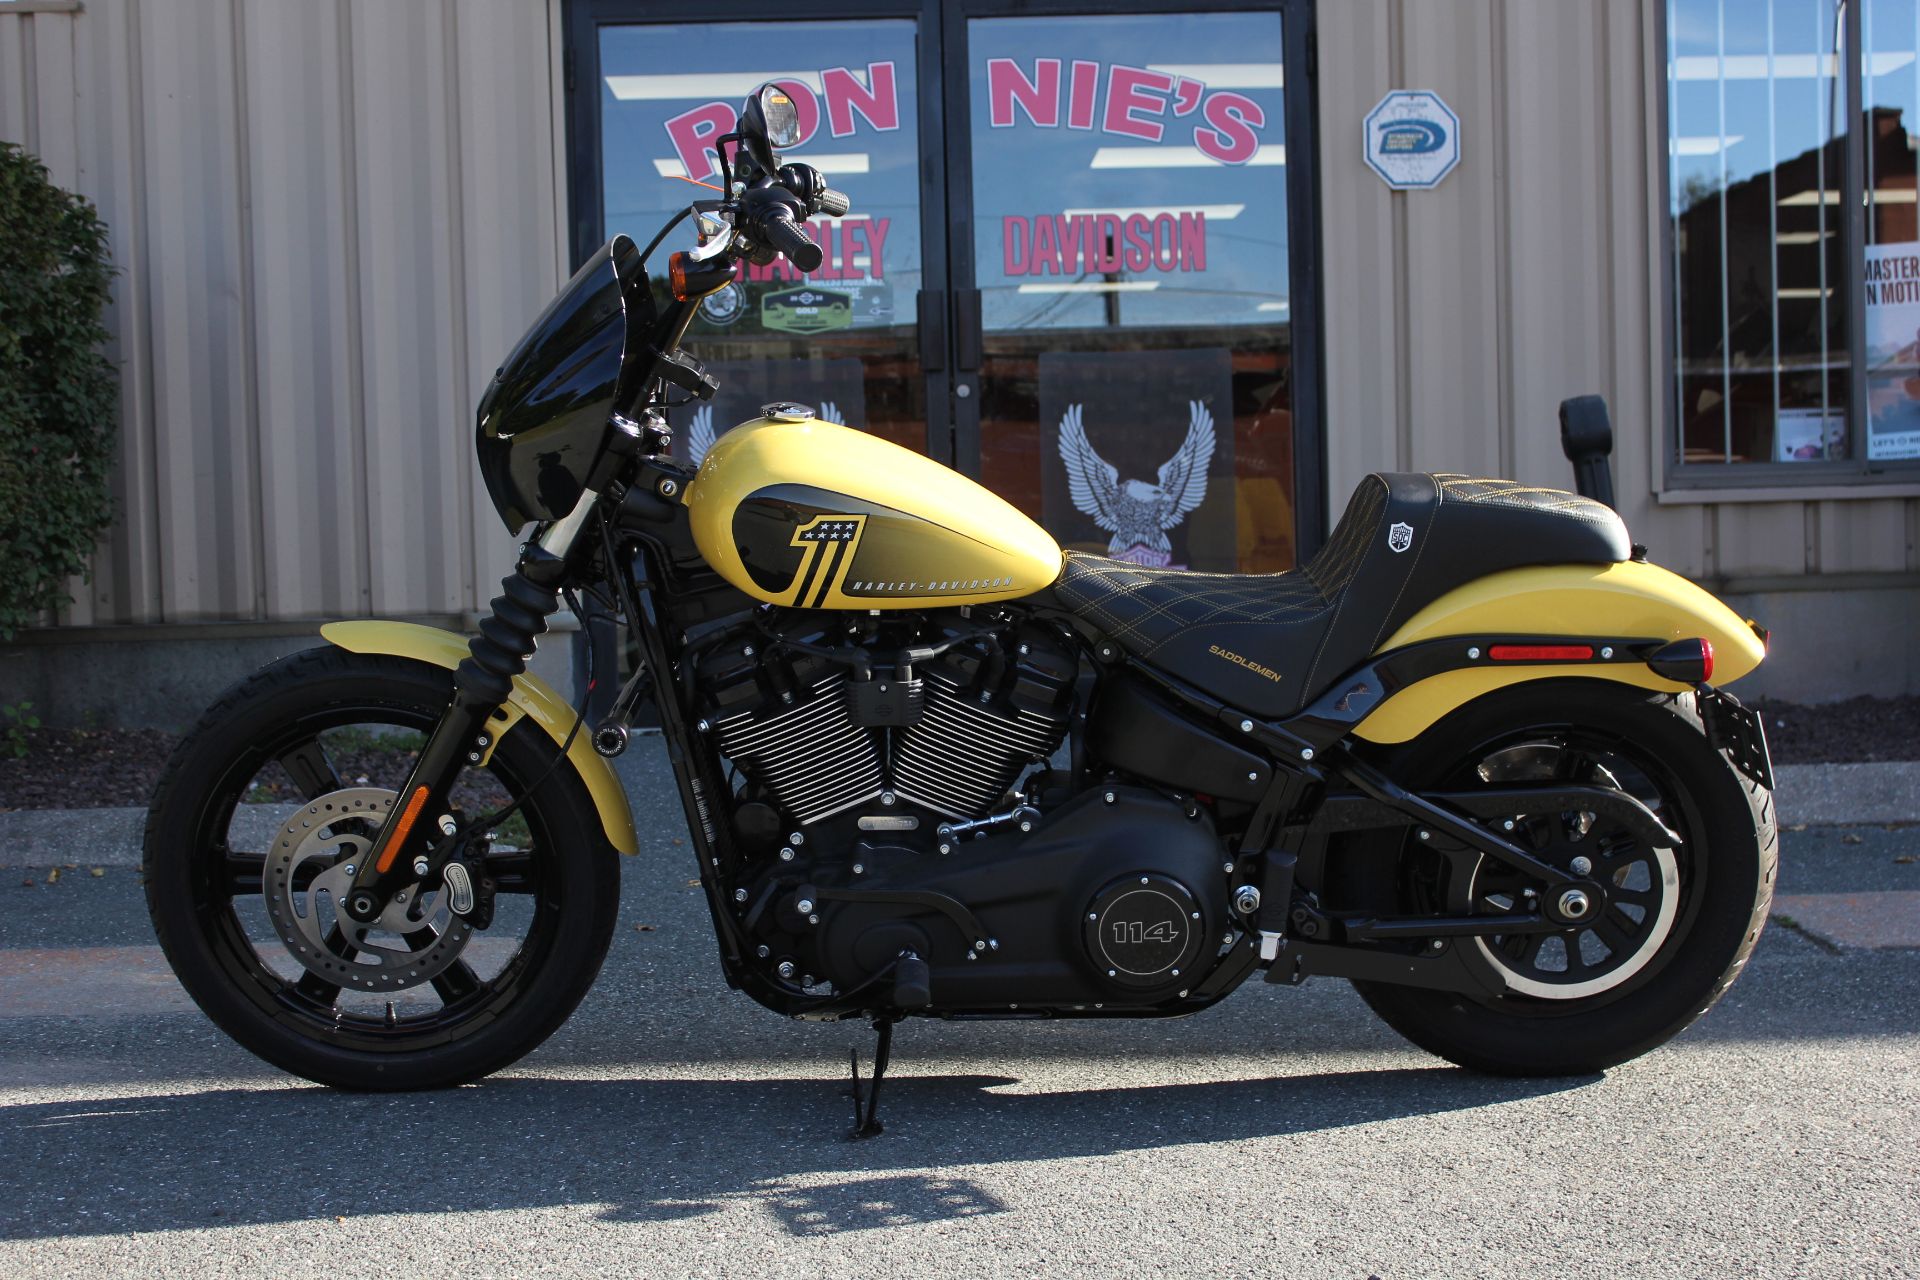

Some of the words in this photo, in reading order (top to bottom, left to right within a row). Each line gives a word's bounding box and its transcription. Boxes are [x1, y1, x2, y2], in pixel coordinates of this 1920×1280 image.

[987, 58, 1265, 165] NIE'S
[735, 217, 890, 282] LEY
[1003, 212, 1206, 276] DAVIDSON
[853, 576, 1012, 590] HARLEY-DAVIDSON
[1209, 645, 1282, 683] SADDLEMEN
[1113, 921, 1179, 943] 114
